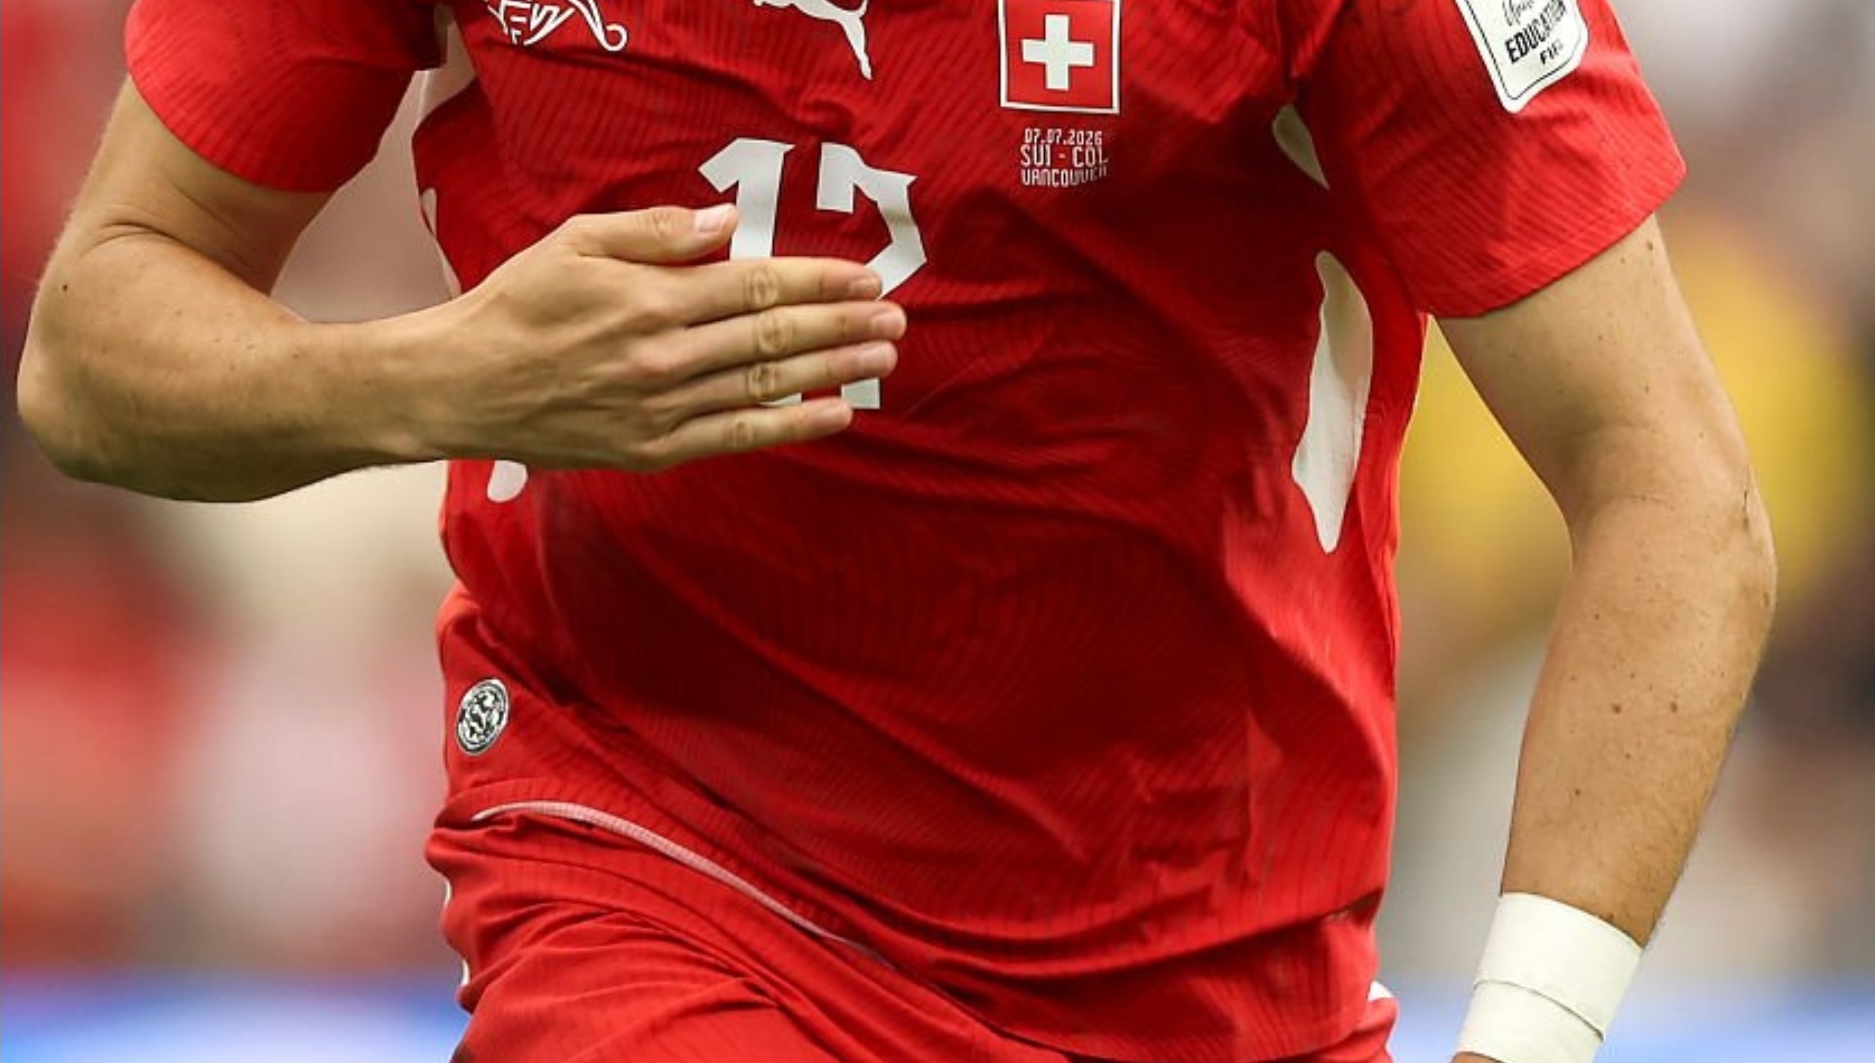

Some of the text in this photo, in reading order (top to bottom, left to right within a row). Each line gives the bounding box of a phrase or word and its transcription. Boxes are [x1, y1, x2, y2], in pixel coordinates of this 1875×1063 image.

[1024, 127, 1103, 146] 07.07.2026
[1020, 144, 1051, 168] SUI
[1072, 146, 1109, 169] COL
